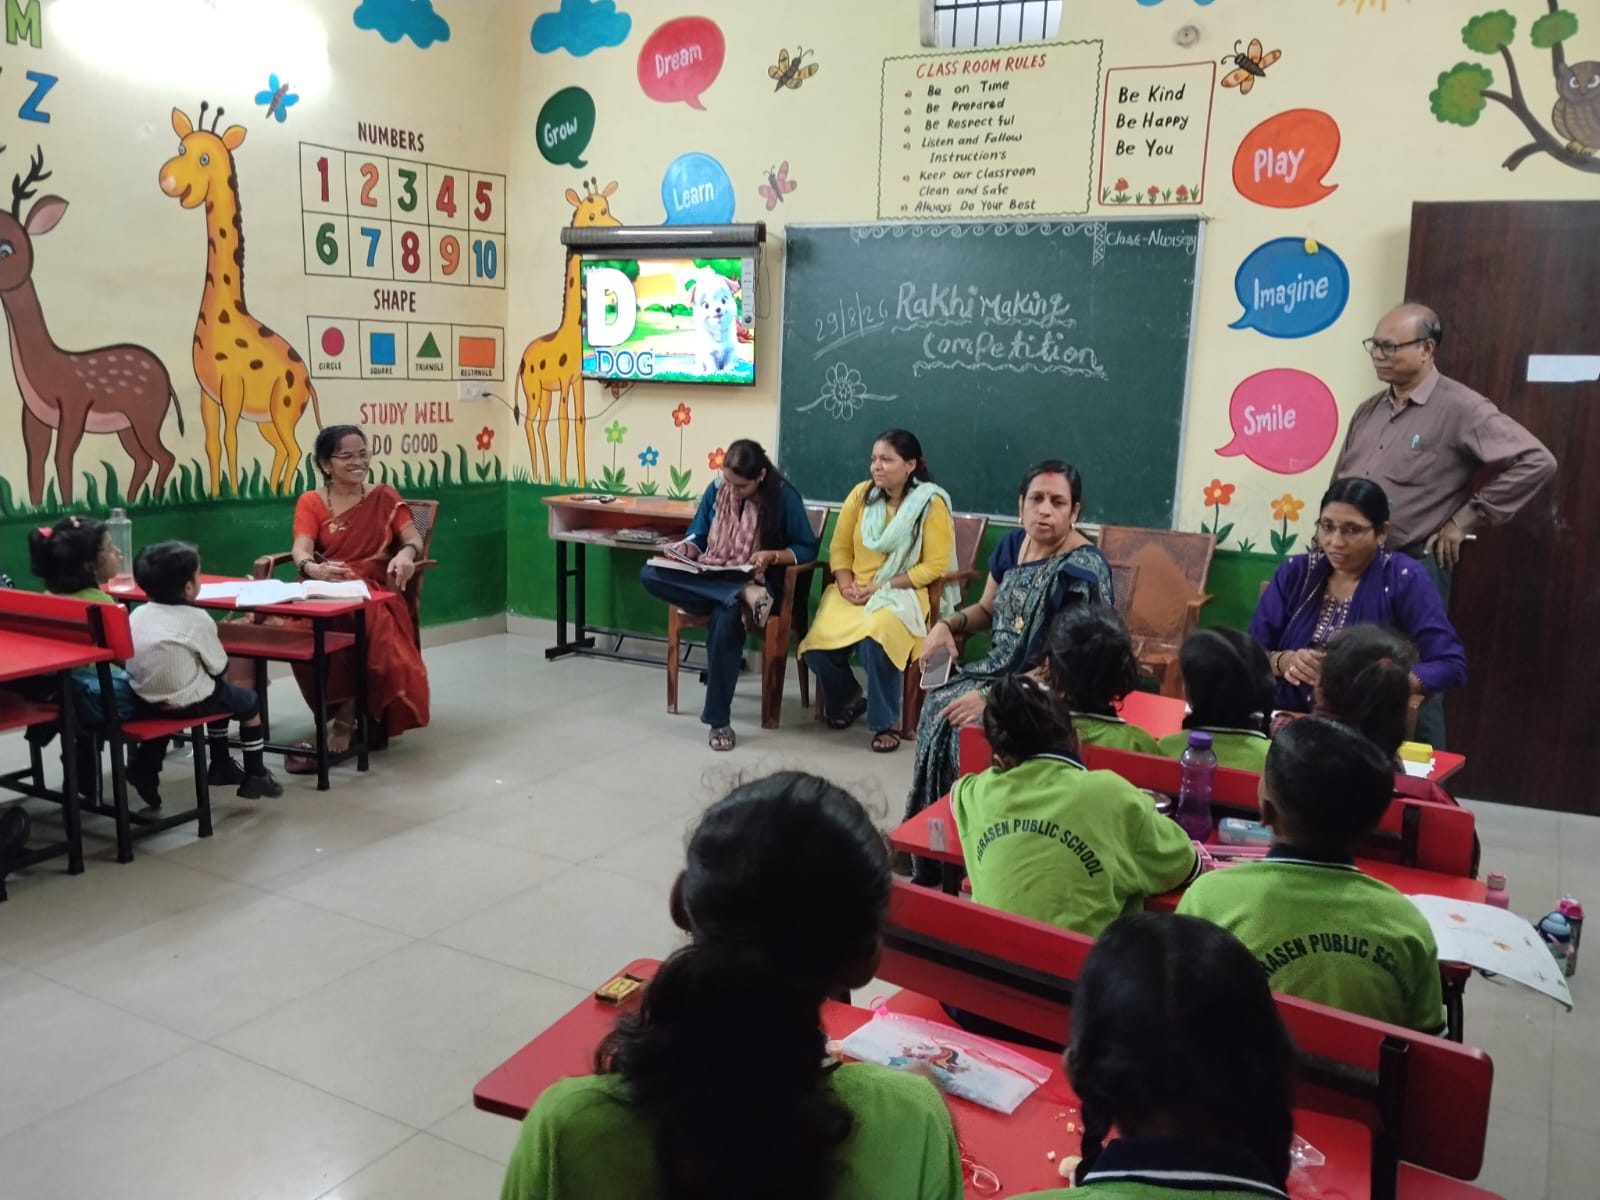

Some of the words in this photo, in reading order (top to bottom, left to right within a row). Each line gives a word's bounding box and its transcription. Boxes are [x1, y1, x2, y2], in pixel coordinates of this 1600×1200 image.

[5, 0, 42, 48] M
[655, 44, 703, 79] Dream
[916, 60, 960, 79] CLASS
[962, 59, 1001, 74] ROOM
[1004, 53, 1047, 71] RULES
[18, 70, 58, 123] Z
[953, 85, 970, 94] on
[980, 80, 1010, 93] Time
[1118, 86, 1140, 104] Be
[1148, 83, 1186, 103] Kind
[926, 103, 940, 114] Be
[1116, 112, 1137, 129] Be
[357, 121, 425, 152] NUMBERS
[544, 117, 578, 147] Grow
[921, 136, 954, 148] Listen
[958, 135, 979, 145] and
[1115, 139, 1136, 156] Be
[1145, 138, 1174, 157] You
[1254, 147, 1305, 184] Play
[317, 157, 330, 202] 1
[360, 163, 379, 208] 2
[397, 168, 418, 212] 3
[436, 175, 457, 219] 4
[474, 180, 492, 222] 5
[673, 181, 715, 211] Learn
[919, 185, 949, 197] Clean
[956, 184, 978, 195] and
[982, 182, 1009, 196] Safe
[914, 201, 952, 213] Always
[960, 200, 975, 211] Do
[981, 200, 1004, 211] Your
[1009, 198, 1037, 210] Best
[316, 222, 339, 265] 6
[360, 226, 381, 267] 7
[401, 231, 421, 273] 8
[439, 235, 460, 275] 9
[472, 239, 497, 279] 10
[373, 289, 416, 313] SHAPE
[586, 267, 637, 347] D
[1253, 273, 1329, 314] Imagine
[318, 361, 342, 371] CIRCLE
[596, 349, 654, 376] DOG
[360, 402, 408, 425] STUDY
[415, 401, 454, 425] WELL
[1243, 404, 1296, 436] Smile
[372, 434, 393, 456] DO
[400, 432, 438, 455] GOOD
[1013, 818, 1060, 839] PUBLIC
[1060, 829, 1104, 878] SCHOOL
[1308, 932, 1369, 959] PUBLIC
